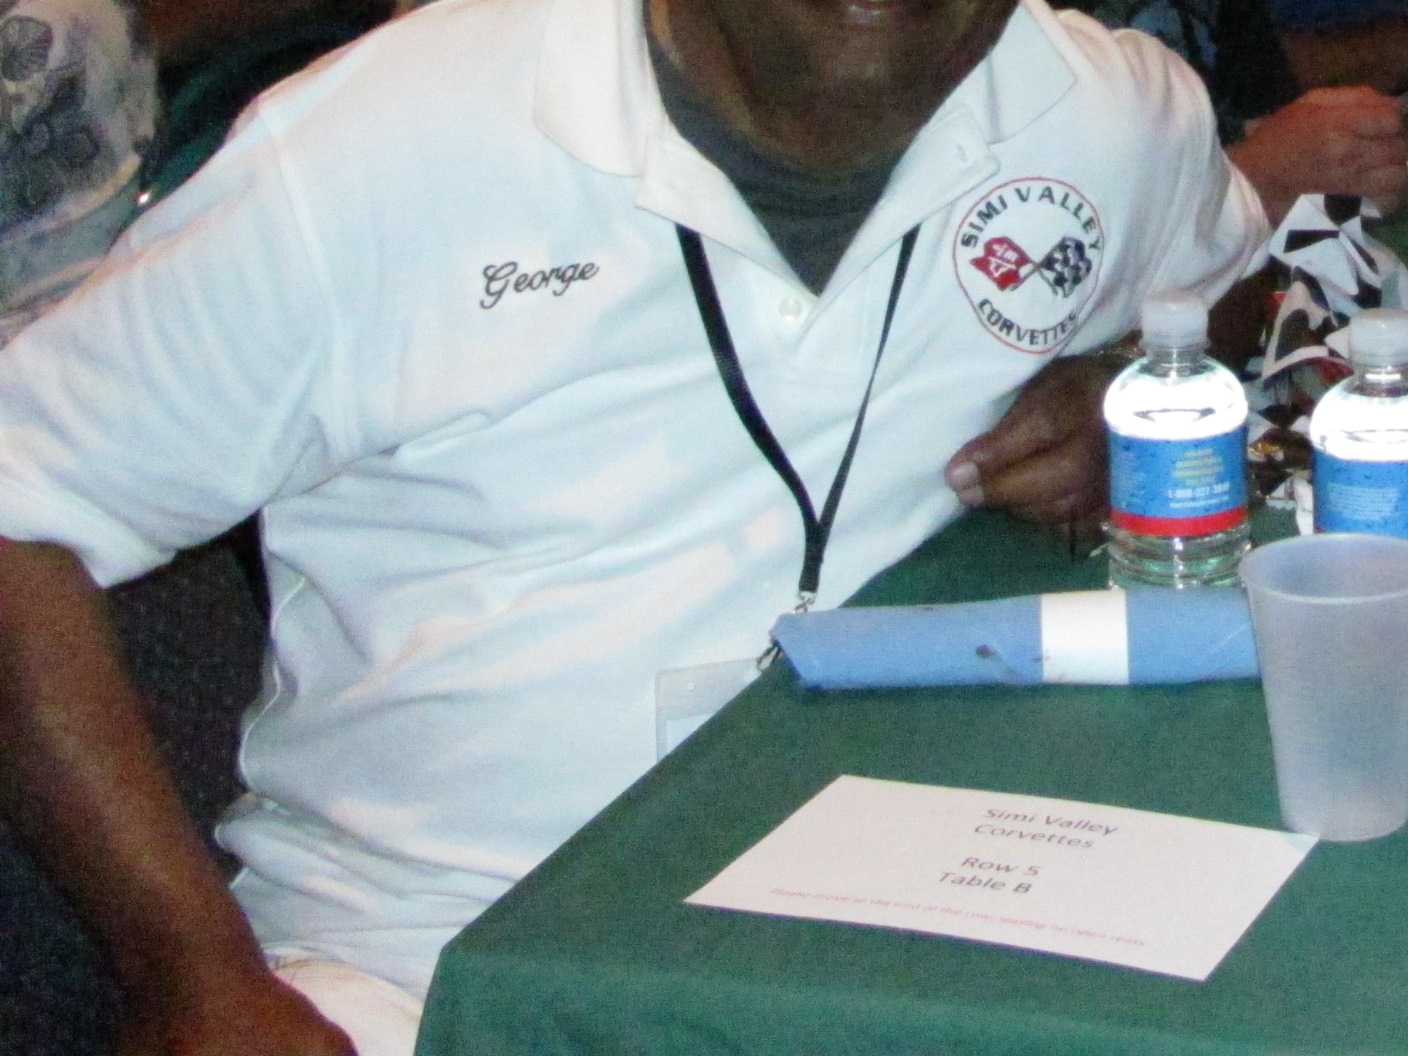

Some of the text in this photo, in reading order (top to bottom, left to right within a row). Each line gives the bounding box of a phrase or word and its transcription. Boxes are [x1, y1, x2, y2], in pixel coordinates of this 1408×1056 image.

[961, 185, 1101, 251] SIMI VALLEY
[479, 261, 600, 310] George
[983, 808, 1120, 836] Simi Valley
[974, 824, 1096, 849] Corvettes
[960, 856, 1043, 876] Row 5
[939, 872, 1033, 894] Table B
